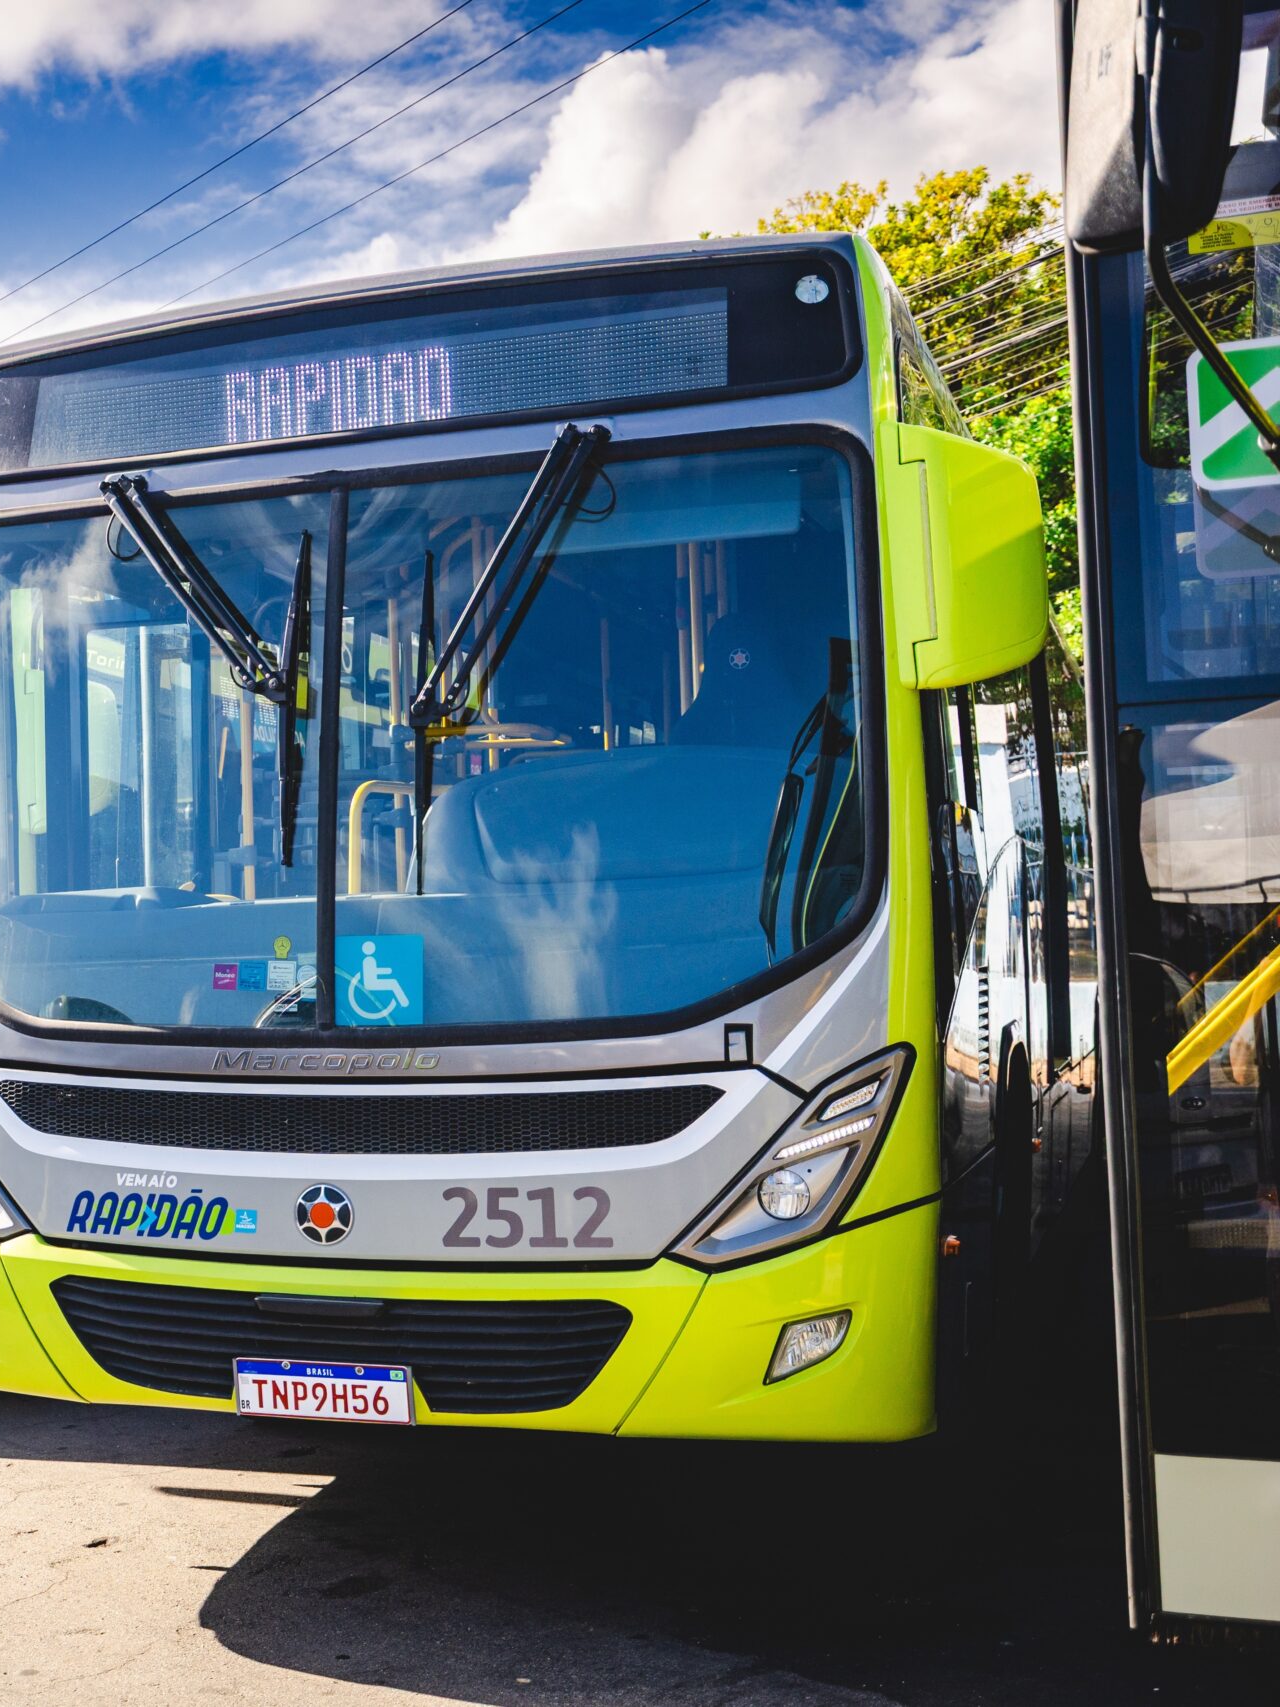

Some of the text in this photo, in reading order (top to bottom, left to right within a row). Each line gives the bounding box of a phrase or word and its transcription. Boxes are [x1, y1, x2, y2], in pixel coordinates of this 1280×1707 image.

[225, 347, 452, 444] RAPIDAO
[211, 1047, 441, 1075] Marcopolo
[116, 1170, 178, 1189] VEM AÍ O
[66, 1188, 229, 1241] RAPIDÃO
[442, 1185, 614, 1249] 2512
[306, 1367, 334, 1377] BRASIL
[241, 1399, 251, 1410] BR
[252, 1379, 389, 1416] TNP9H56
